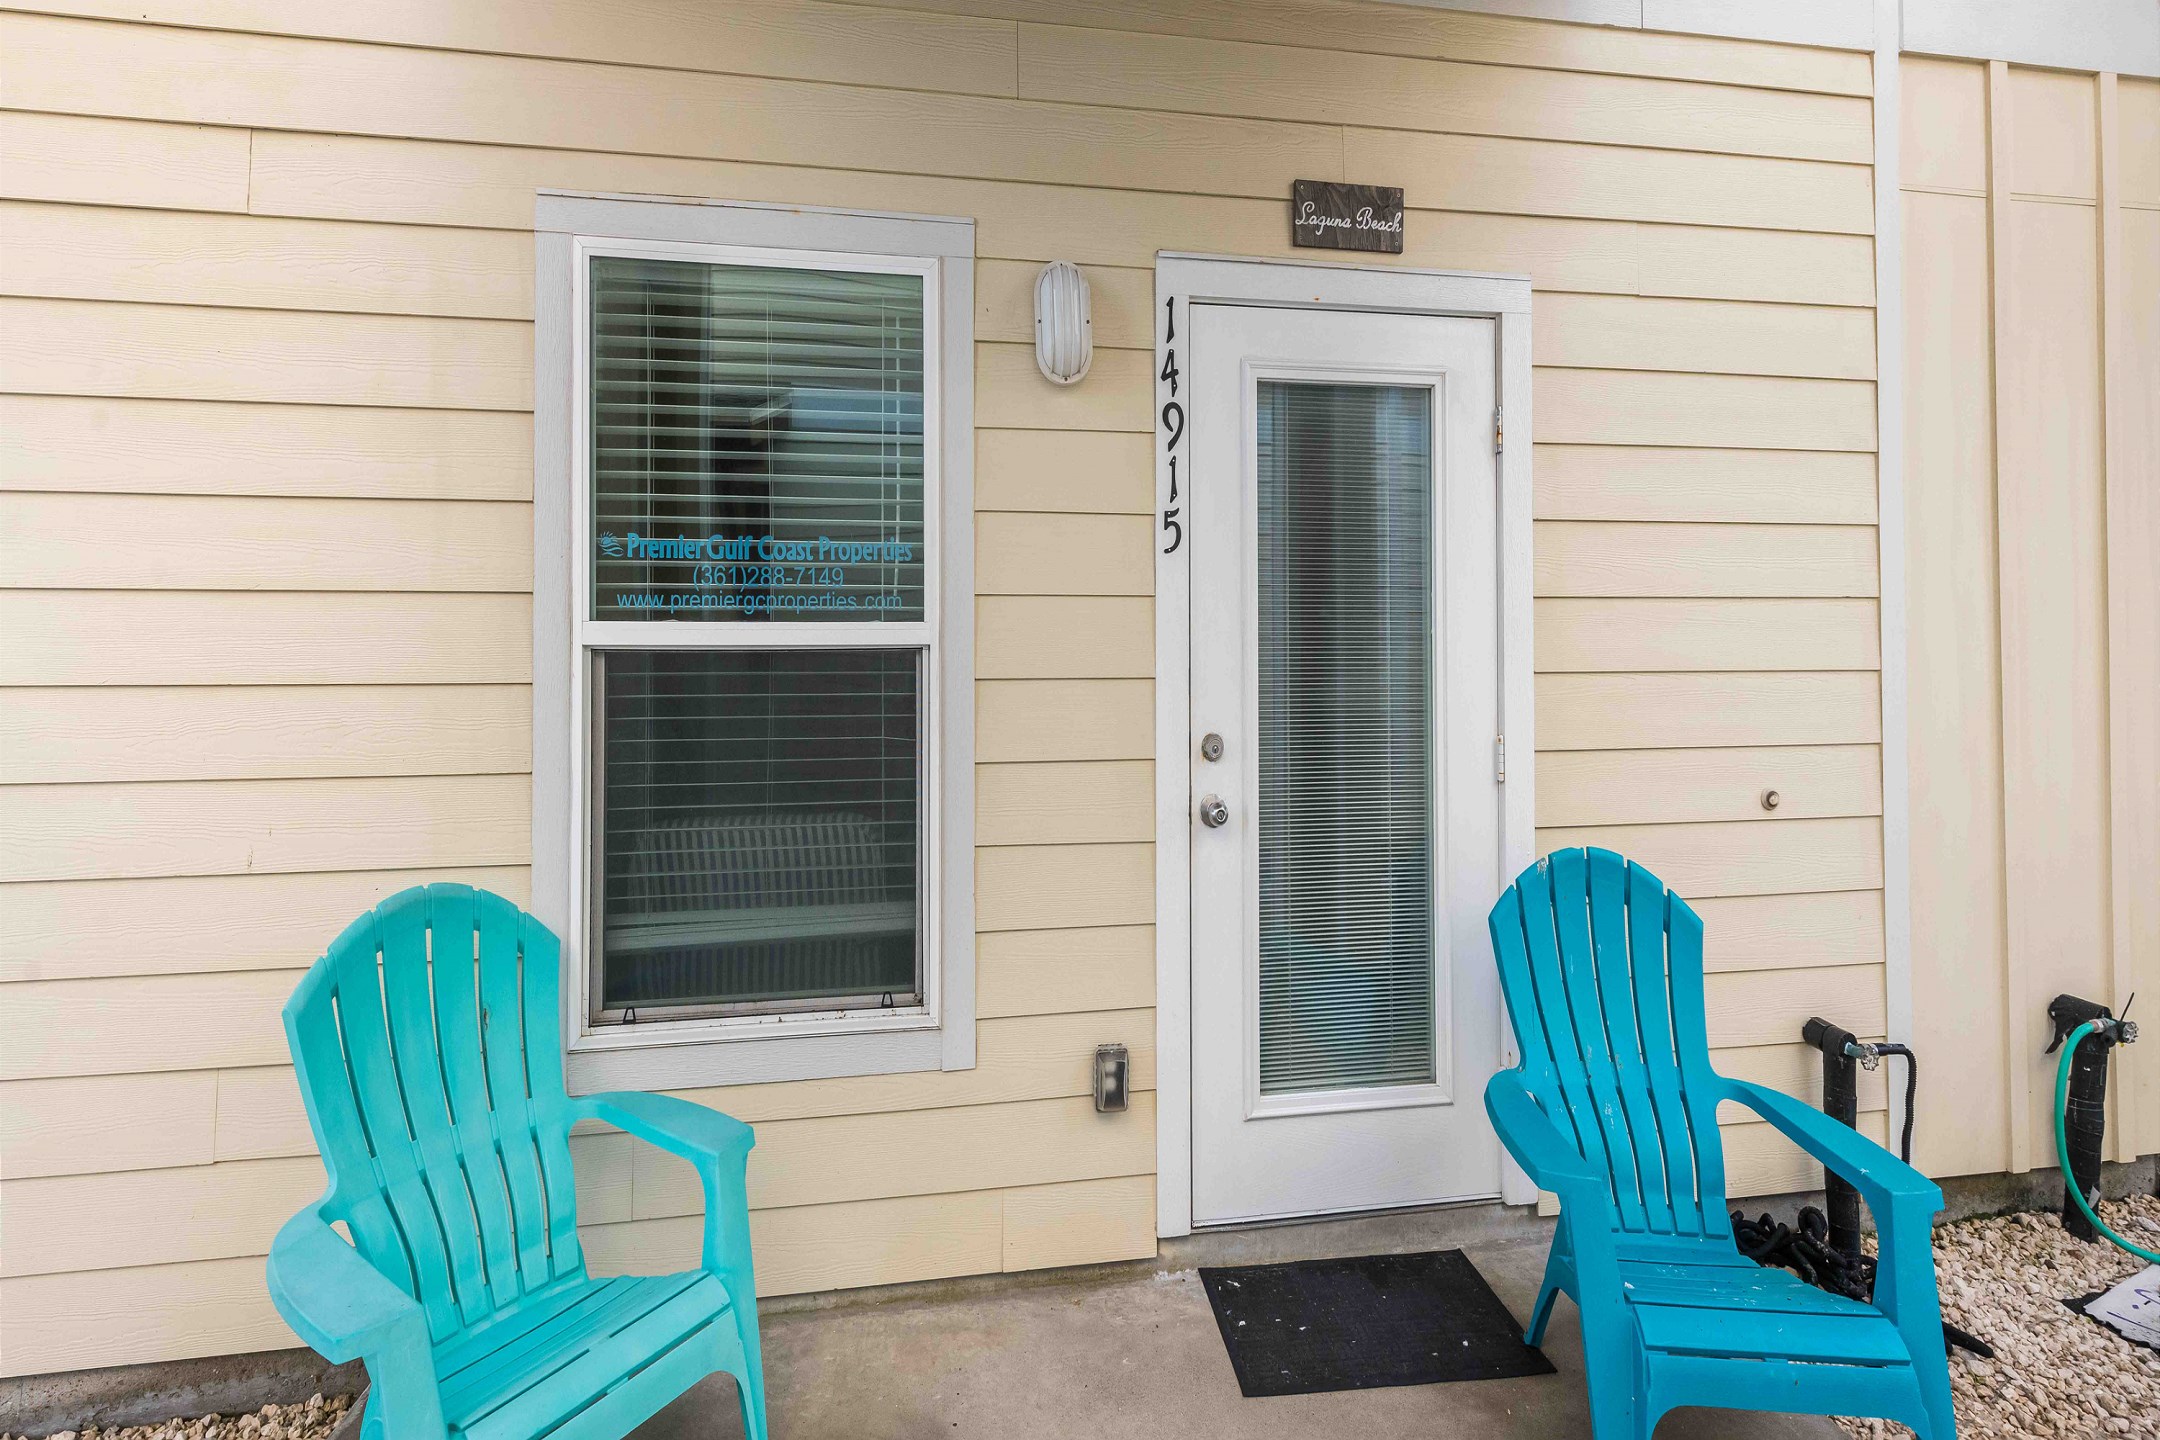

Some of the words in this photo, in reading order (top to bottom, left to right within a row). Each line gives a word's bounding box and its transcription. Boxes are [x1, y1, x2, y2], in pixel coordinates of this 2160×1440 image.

[1295, 201, 1352, 235] Laguna
[1356, 206, 1402, 232] Beach
[1160, 296, 1184, 554] 14915
[627, 532, 704, 559] Premier
[707, 533, 753, 560] Gulf
[757, 535, 814, 561] Coast
[818, 535, 913, 564] Properties
[692, 564, 844, 591] (361)288-7149
[617, 591, 902, 615] www.premiergcproperties.com
